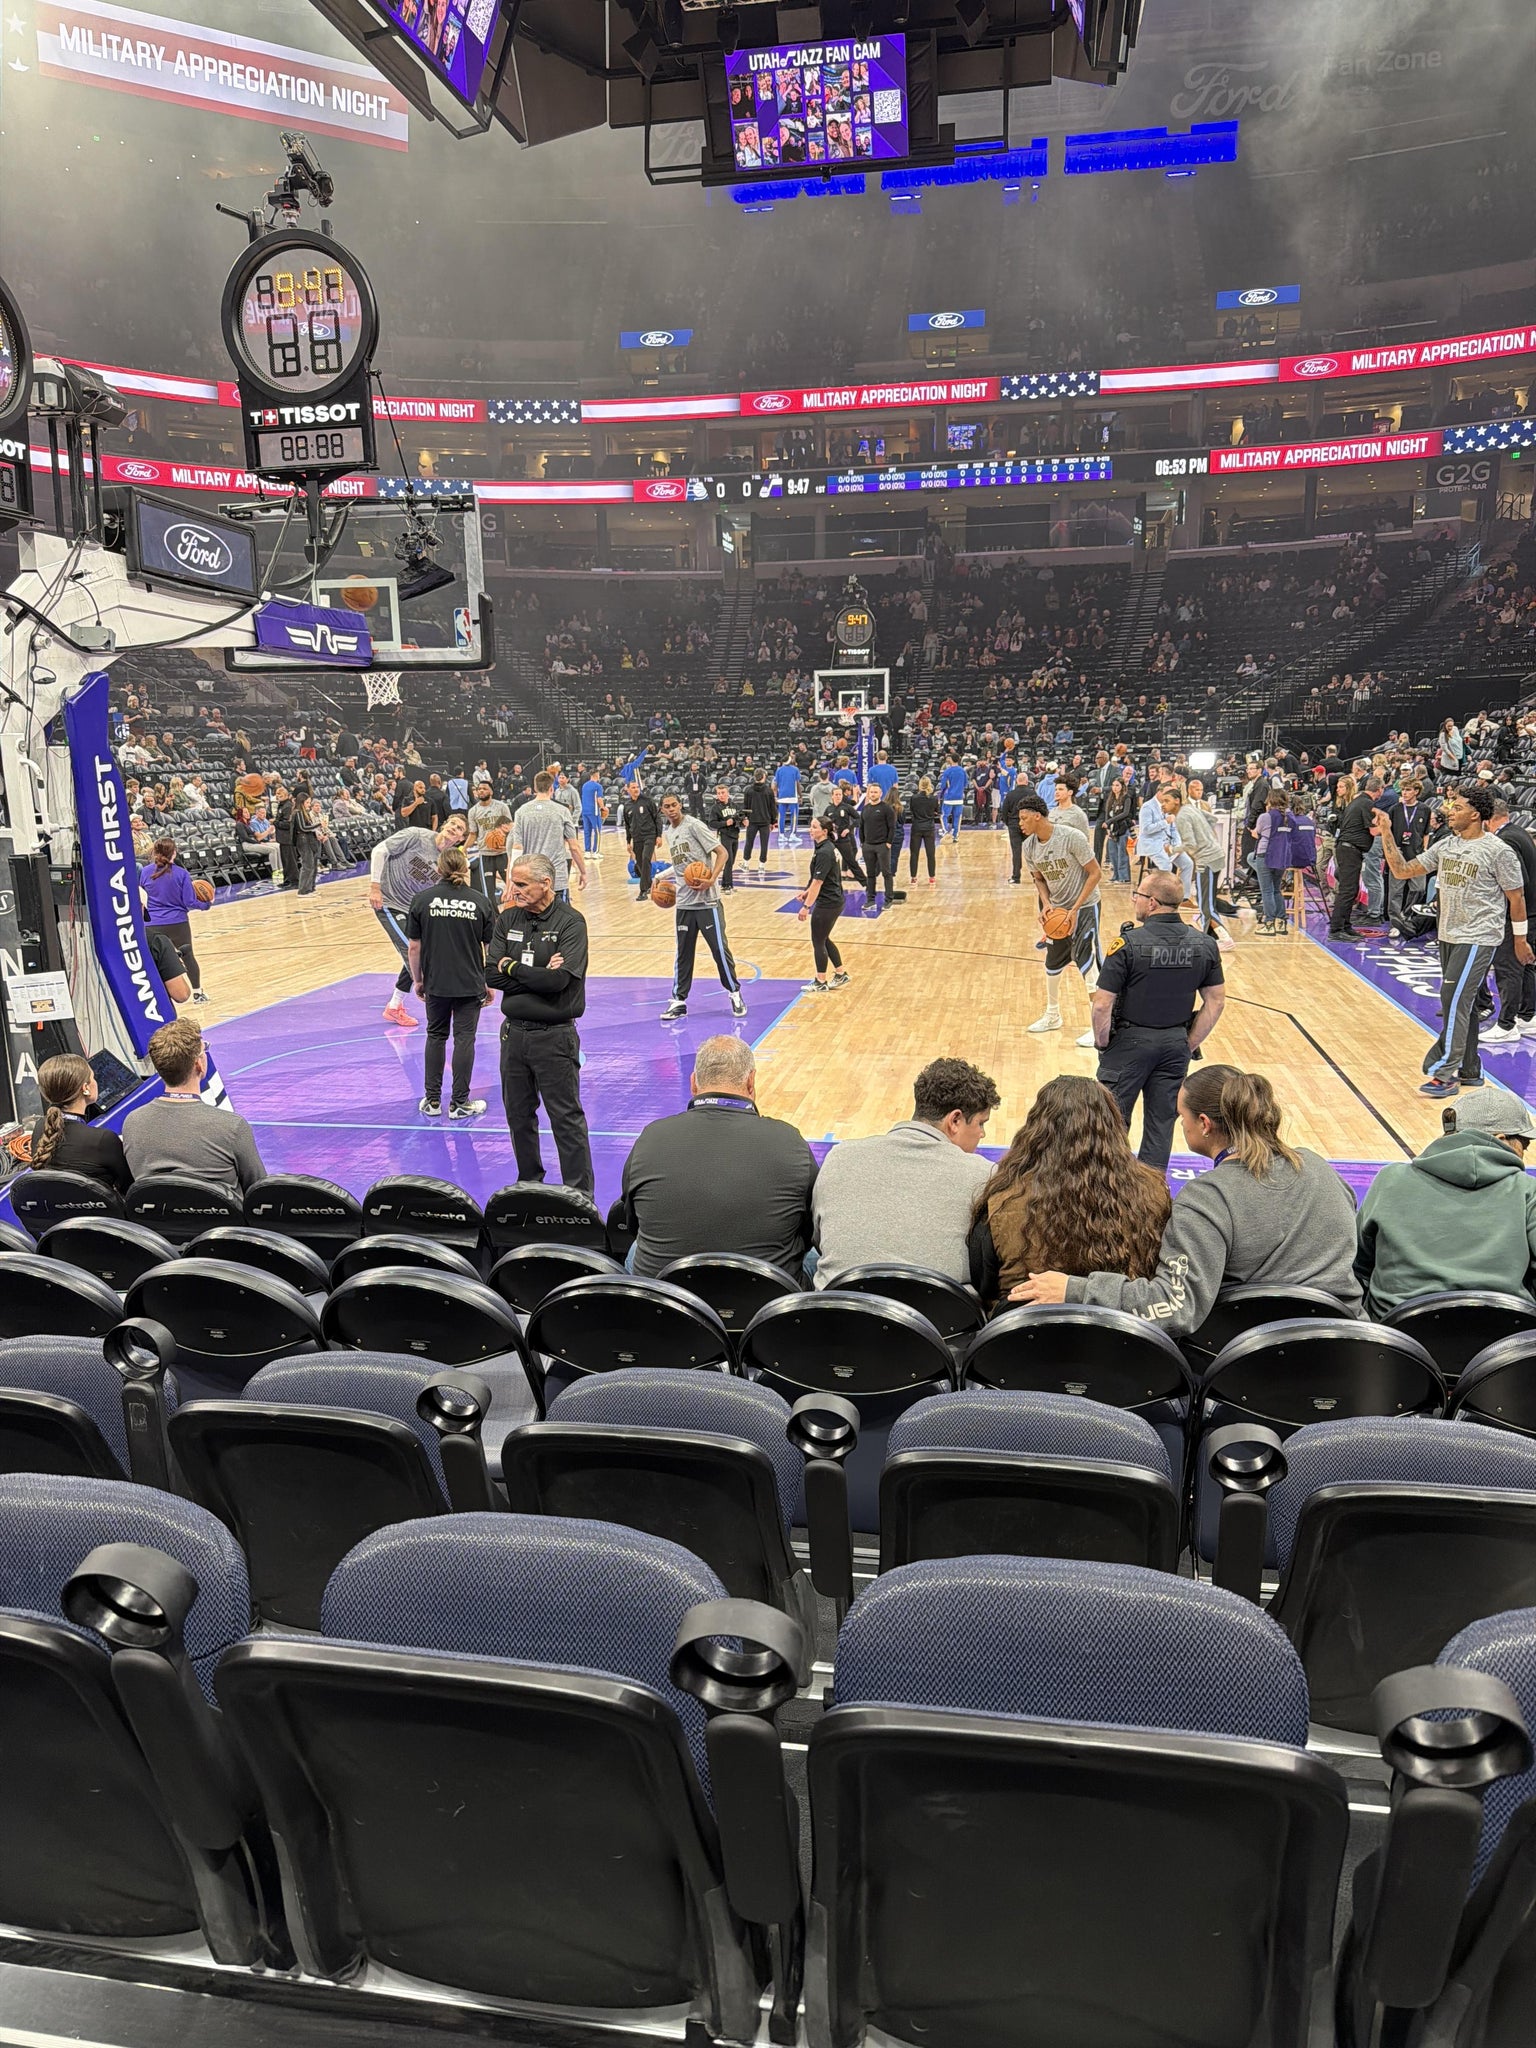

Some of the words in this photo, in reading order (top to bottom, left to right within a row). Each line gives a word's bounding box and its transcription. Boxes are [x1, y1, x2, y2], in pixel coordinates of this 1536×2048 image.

[749, 53, 780, 71] UTAH
[793, 48, 823, 67] JAZZ
[826, 46, 850, 64] FAN
[853, 42, 881, 61] CAM
[1376, 50, 1442, 73] Zone
[58, 23, 165, 71] MILITARY
[173, 50, 325, 107] APPRECIATION
[332, 86, 389, 121] NIGHT
[1170, 60, 1300, 119] Ford
[1245, 291, 1270, 304] Ford
[934, 314, 960, 328] Ford
[644, 332, 669, 345] Ford
[1301, 359, 1331, 374] Ford
[1352, 349, 1416, 371] MILITARY
[1420, 332, 1525, 363] APPRECIATION
[759, 395, 784, 408] Ford
[803, 390, 858, 408] MILITARY
[861, 385, 947, 405] APPRECIATION
[951, 382, 988, 398] NIGHT
[280, 403, 360, 425] TISSOT
[373, 400, 436, 417] RECIATION
[439, 402, 476, 419] NIGHT
[1220, 449, 1281, 469] MILITARY
[1284, 443, 1384, 465] APPRECIATION
[1386, 438, 1429, 455] NIGHT
[1155, 460, 1187, 476] 06:53
[1189, 458, 1207, 474] PM
[1436, 461, 1491, 486] G2G
[124, 463, 152, 479] Ford
[172, 468, 231, 486] MILITARY
[328, 481, 365, 495] NIGHT
[716, 483, 726, 498] 0
[742, 482, 751, 497] 0
[787, 479, 809, 495] 9:47
[653, 484, 677, 497] Ford
[177, 529, 221, 569] Ford
[847, 614, 868, 626] 9:47
[95, 755, 124, 862] FIRST
[1463, 862, 1479, 878] FOR
[429, 897, 477, 912] ALSCO
[109, 866, 165, 1023] AMERICA
[1152, 947, 1192, 966] POLICE
[55, 1201, 107, 1210] entrata
[173, 1207, 230, 1216] entrata
[290, 1207, 346, 1216] entrata
[410, 1210, 466, 1222] entrata
[535, 1214, 592, 1226] entrata
